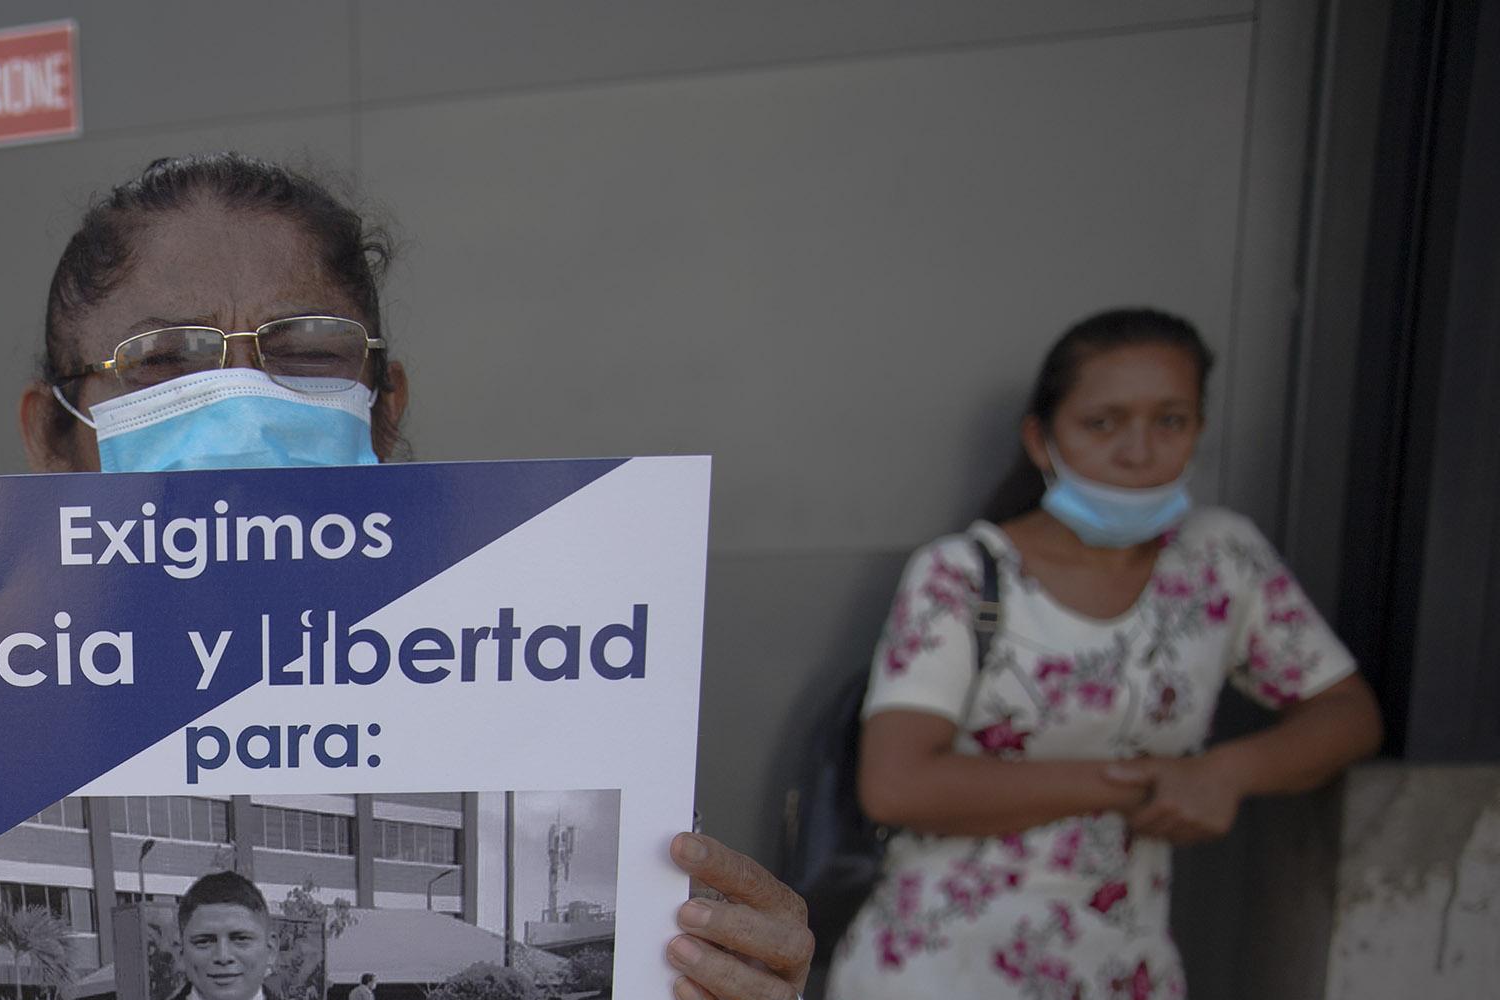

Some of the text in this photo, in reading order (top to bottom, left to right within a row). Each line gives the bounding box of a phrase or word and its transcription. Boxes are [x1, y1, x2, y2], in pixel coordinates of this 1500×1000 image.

[58, 499, 393, 581] Exigimos
[187, 630, 234, 691] y
[260, 602, 650, 687] Libertad
[184, 721, 383, 786] para:
